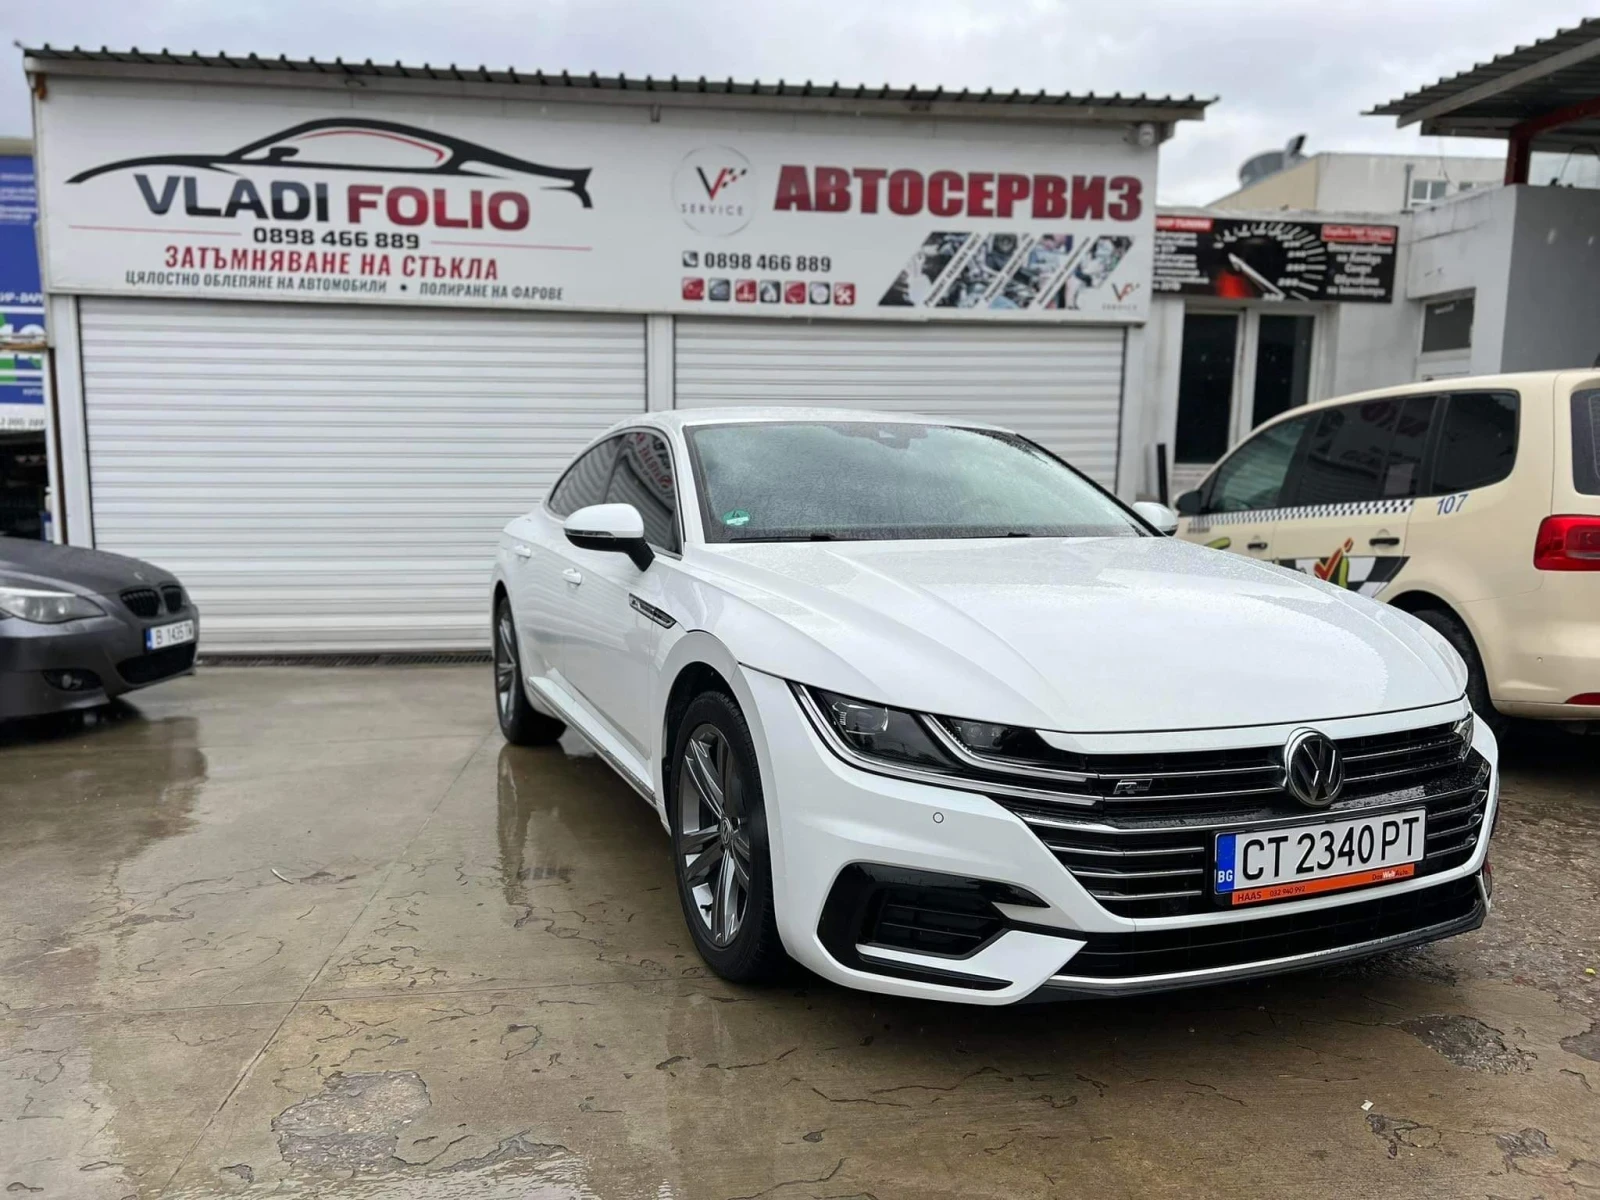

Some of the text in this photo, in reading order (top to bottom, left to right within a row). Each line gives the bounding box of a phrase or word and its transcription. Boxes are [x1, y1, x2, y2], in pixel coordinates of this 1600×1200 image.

[133, 173, 530, 232] VLADI FOLIO
[774, 164, 1143, 222] АВТОСЕРВИЗ
[681, 203, 744, 216] SERVICE
[253, 227, 420, 250] 0898 466 889
[165, 245, 498, 281] ЗАТЪМНЯВАНЕ НА СТЪКЛА
[704, 252, 832, 273] 0898 466 889
[125, 270, 563, 301] ЦЯЛОСТНО ОБЛЕПЯНЕ НА АВТОМОБИЛИ ПОЛИРАНЕ НА ФАРОВЕ
[1436, 493, 1469, 516] 107
[1242, 816, 1420, 881] CT 2340 PT
[1217, 868, 1234, 884] BG
[1237, 891, 1262, 902] HAAS
